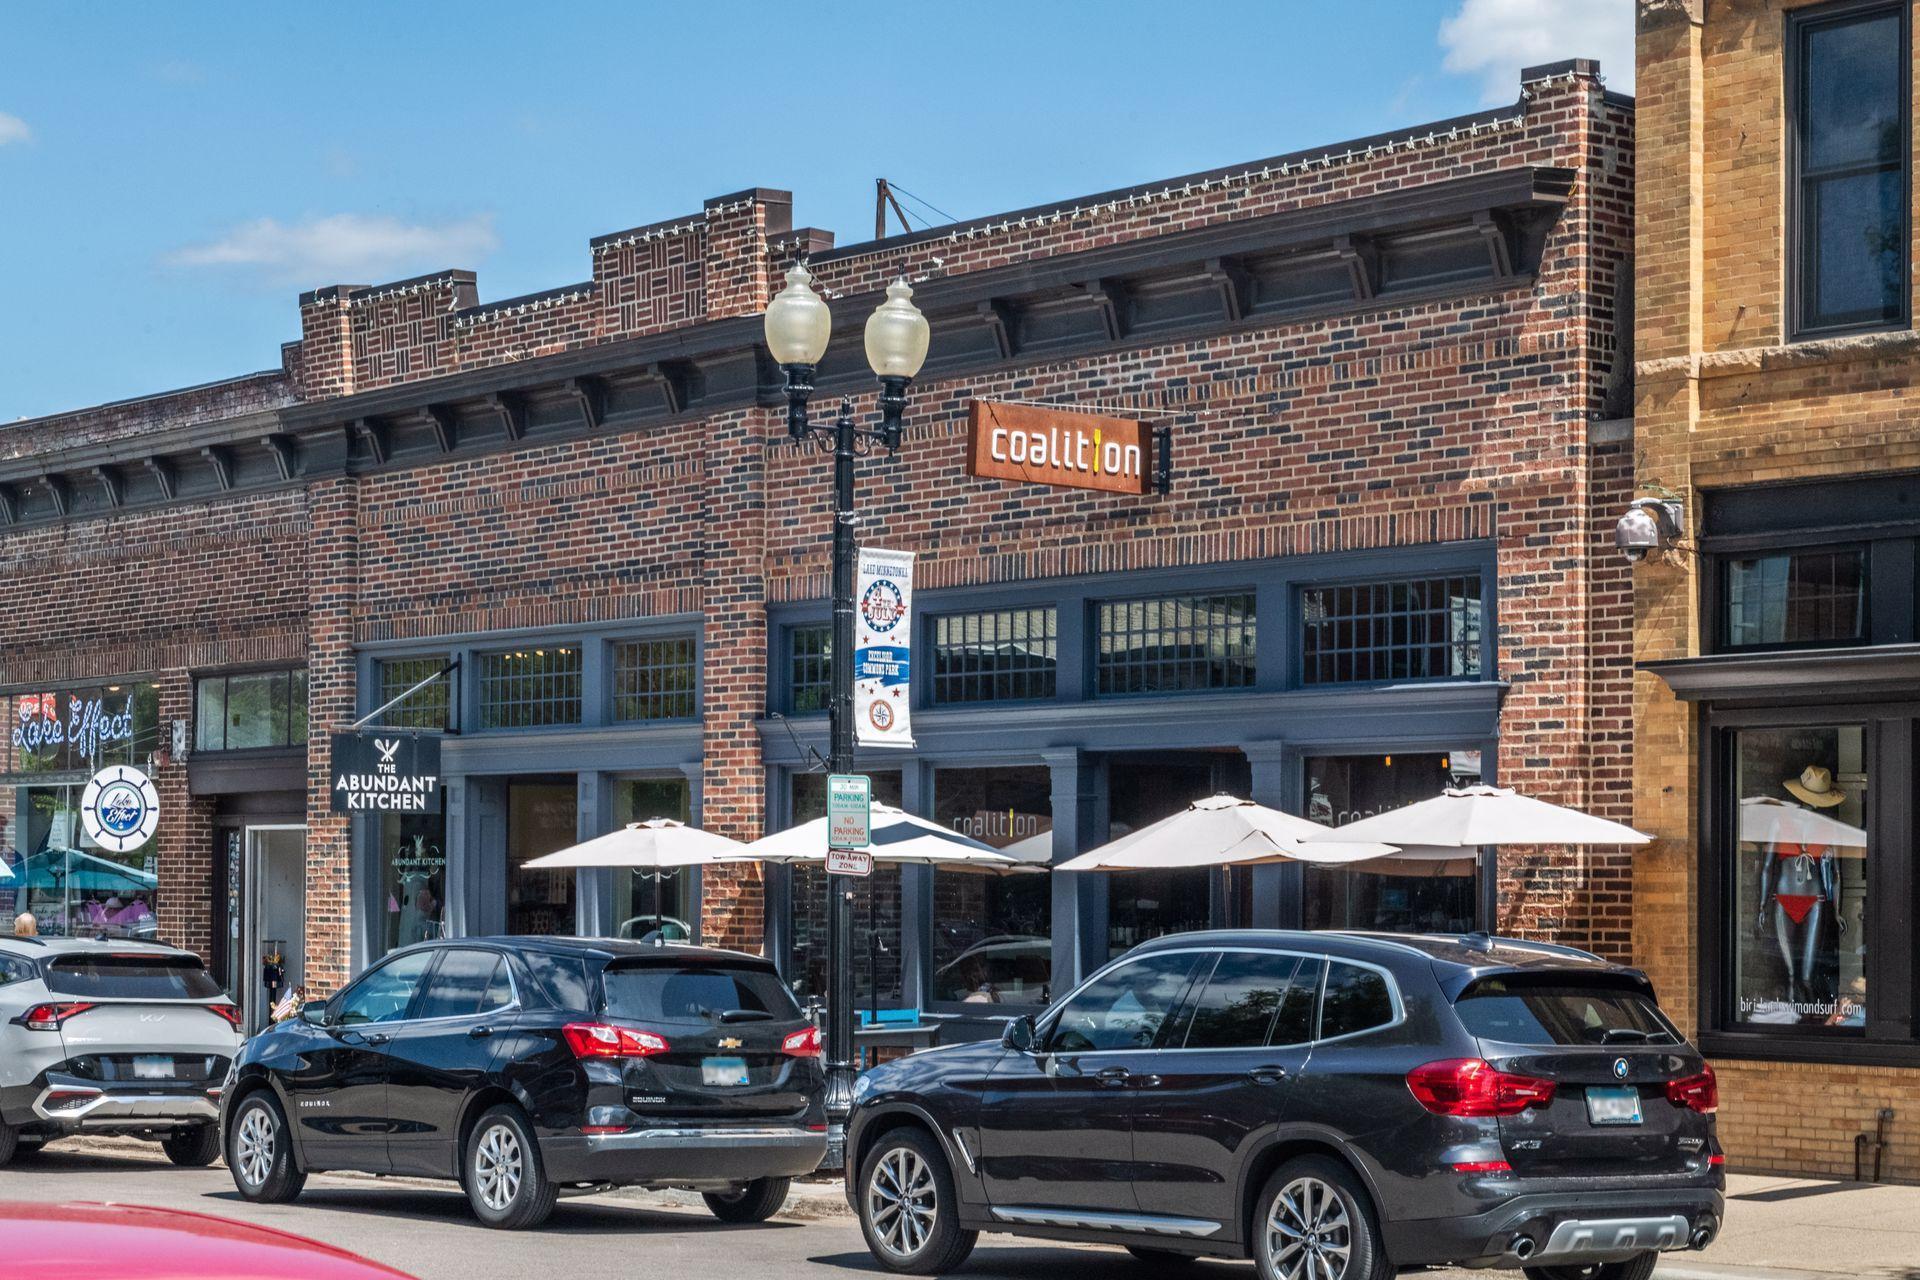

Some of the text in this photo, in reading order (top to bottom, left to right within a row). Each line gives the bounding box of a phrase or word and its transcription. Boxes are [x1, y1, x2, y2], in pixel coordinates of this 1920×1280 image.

[991, 427, 1141, 476] coalition
[868, 606, 897, 621] JULY
[863, 662, 899, 676] COMMONS PARK
[13, 694, 132, 758] Lake Effect
[377, 764, 396, 774] THE
[336, 774, 437, 792] ABUNDANT
[110, 793, 132, 809] Lake
[347, 792, 425, 810] KITCHEN
[834, 793, 864, 801] PARKING
[106, 807, 138, 824] Effect
[844, 817, 855, 825] NO
[953, 808, 1037, 838] coalition
[834, 827, 864, 836] PARKING
[391, 857, 446, 866] ABUNDANT KITCHEN
[632, 1096, 666, 1104] EQUINOX
